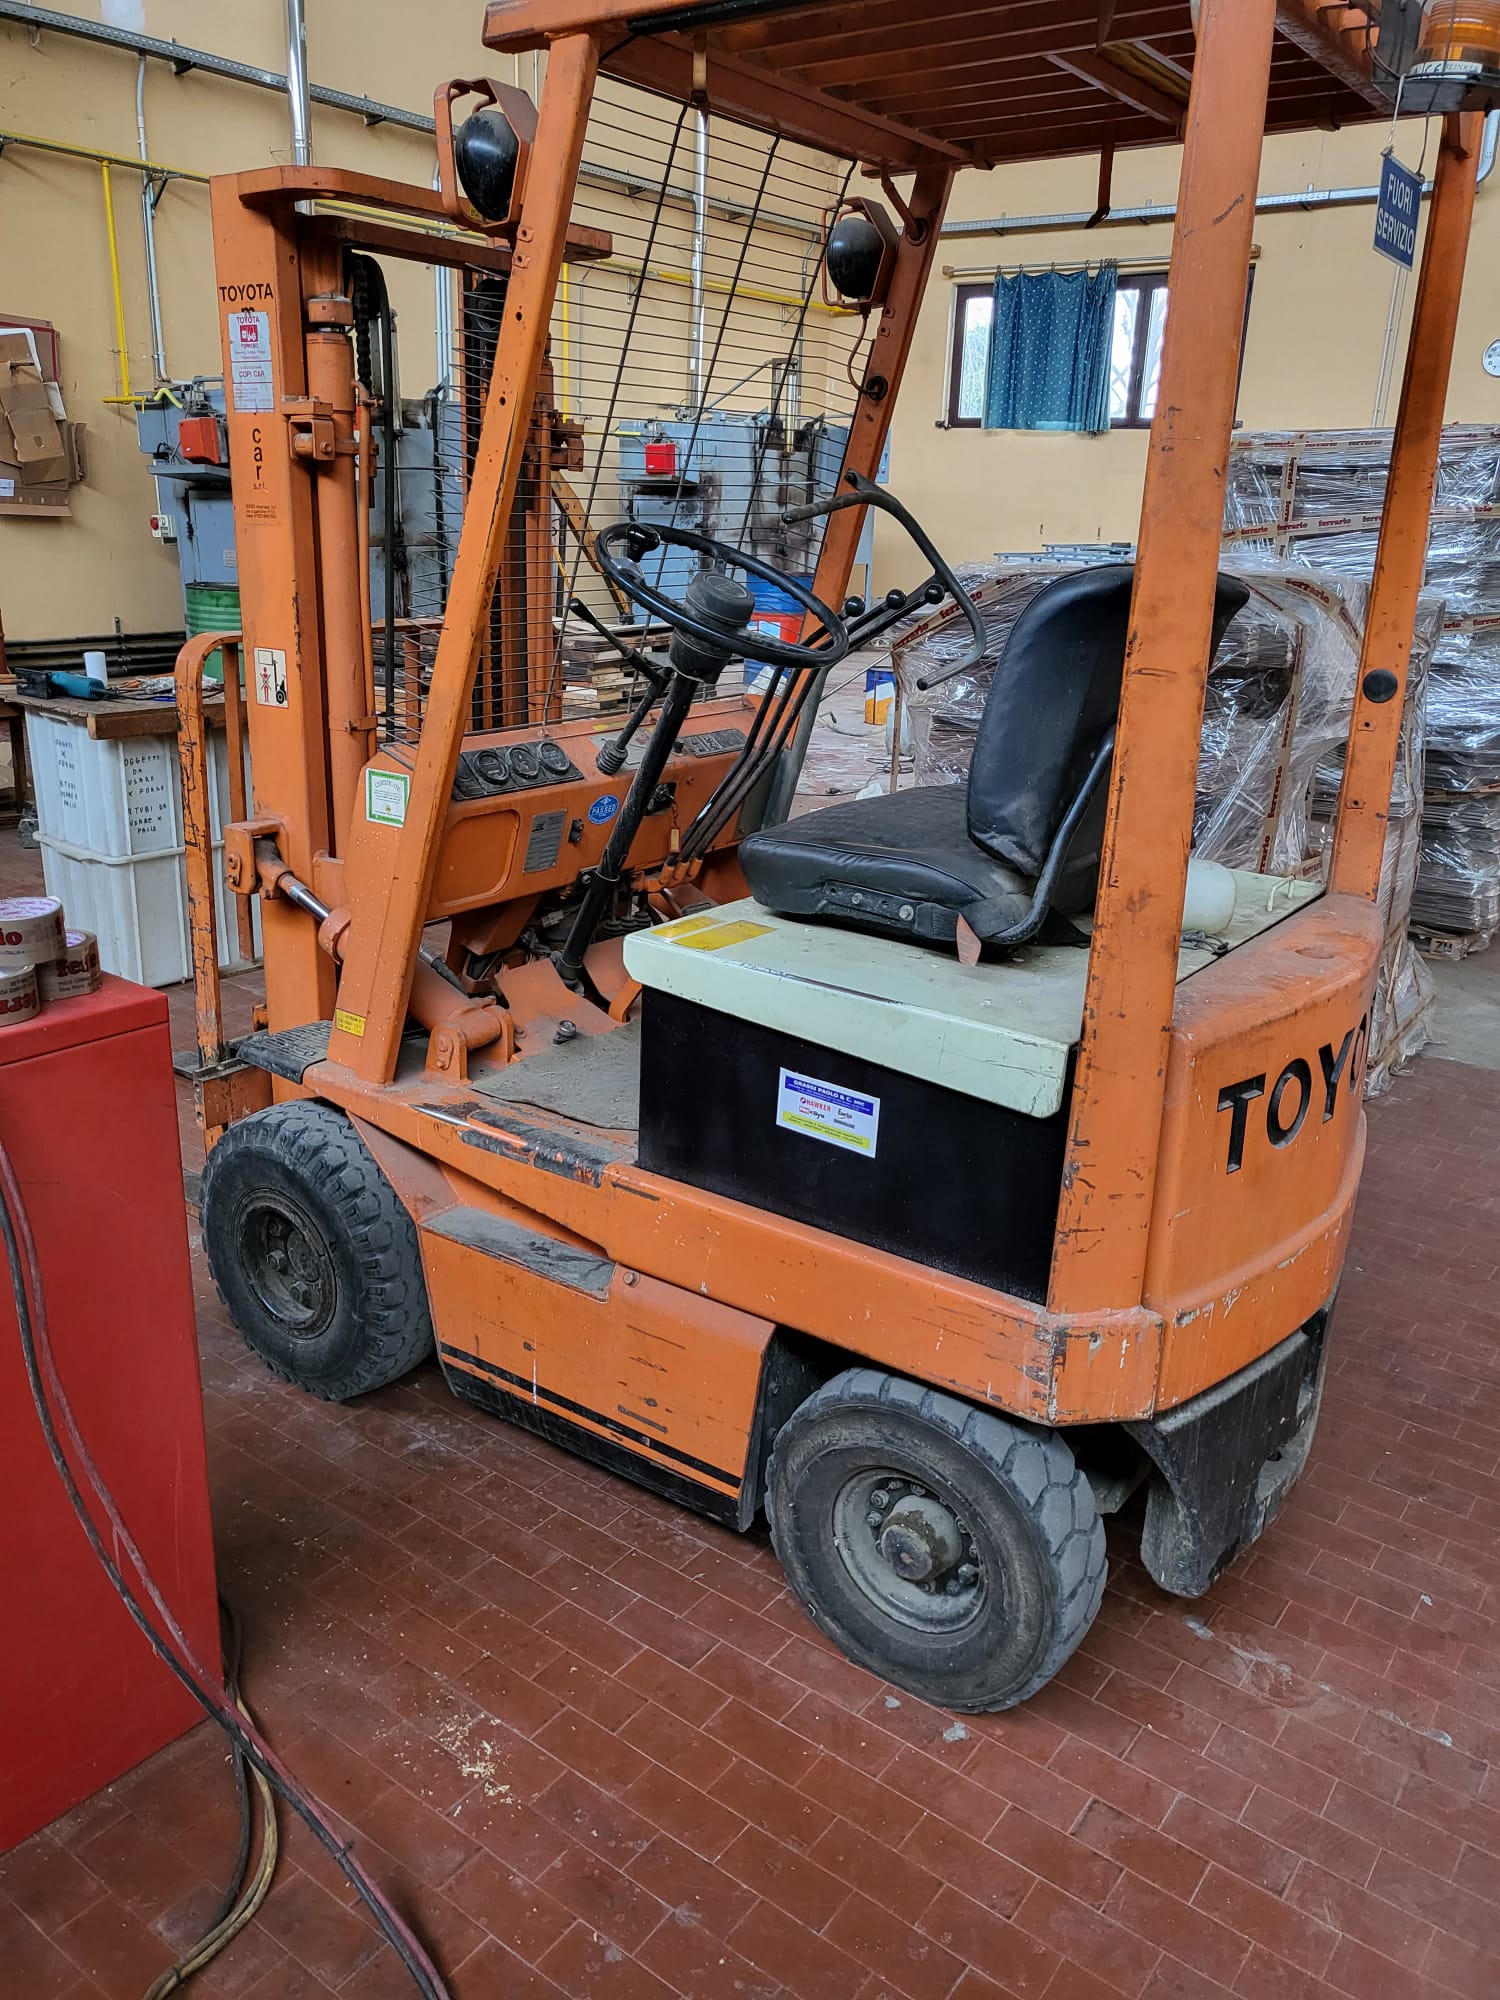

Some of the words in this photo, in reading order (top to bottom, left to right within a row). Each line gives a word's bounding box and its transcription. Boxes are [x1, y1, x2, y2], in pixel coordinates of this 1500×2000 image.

[1387, 173, 1413, 216] FUORI
[1377, 207, 1414, 255] SERVIZIO
[219, 283, 273, 302] TOYOTA
[236, 315, 260, 325] TOYOTA
[817, 1085, 838, 1098] PAOLO
